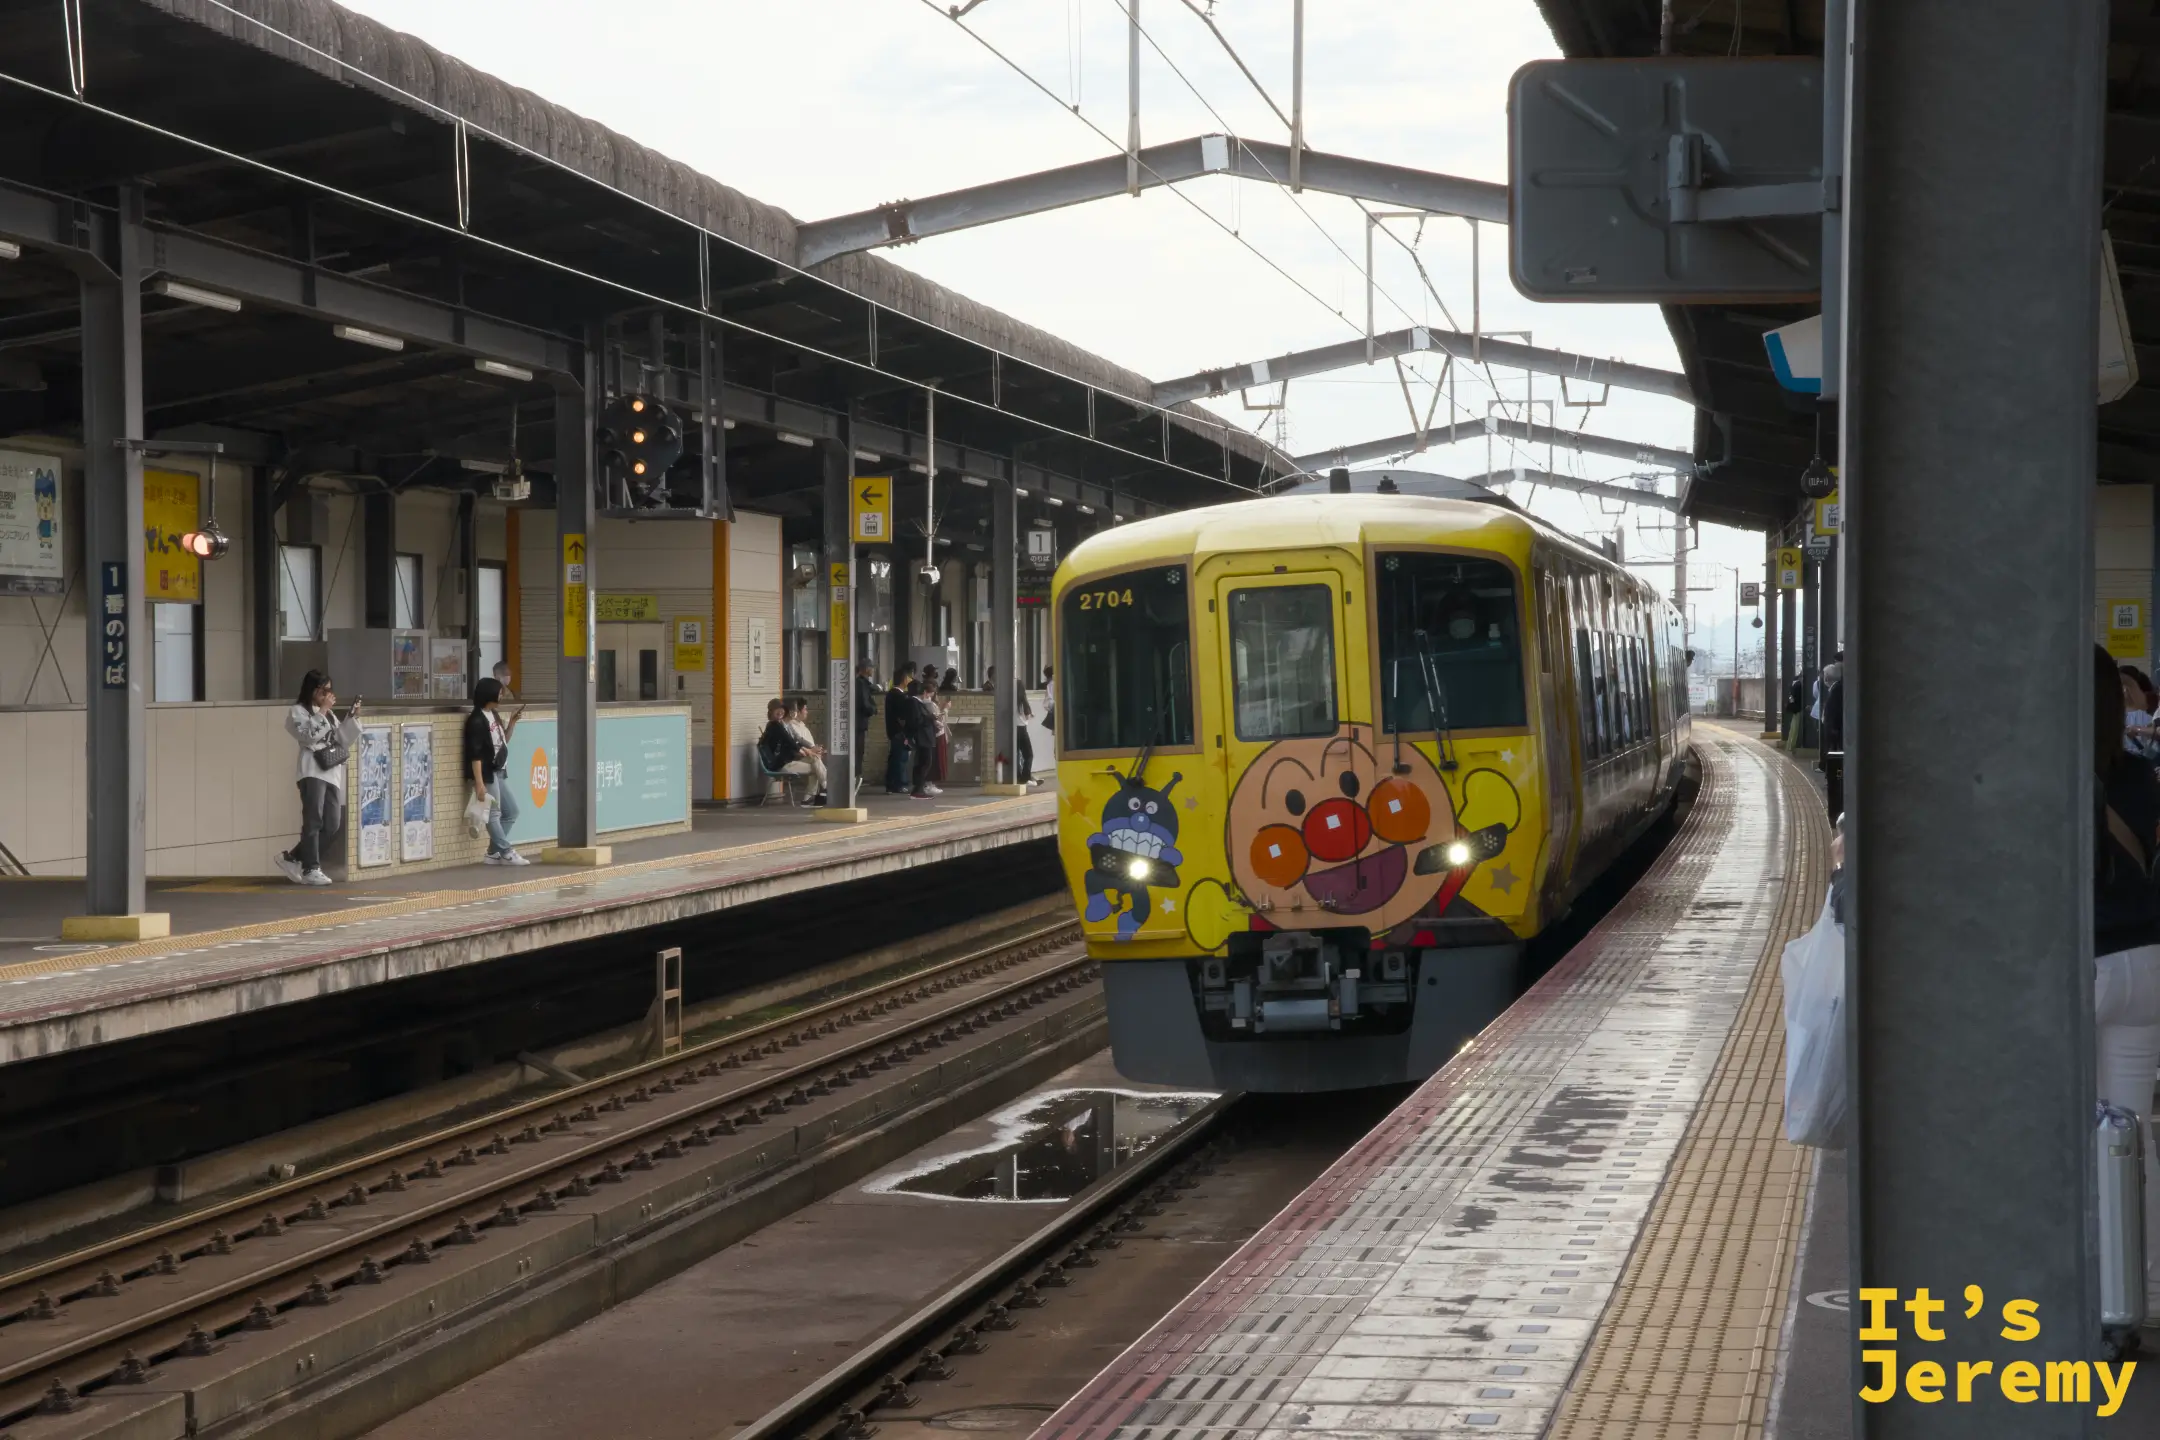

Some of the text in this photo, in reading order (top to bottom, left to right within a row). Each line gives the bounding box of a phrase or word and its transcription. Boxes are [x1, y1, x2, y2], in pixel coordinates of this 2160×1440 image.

[1036, 534, 1042, 553] 1
[1080, 588, 1133, 610] 2704
[1744, 585, 1755, 597] 2
[105, 566, 126, 685] 1番のりば
[532, 765, 548, 790] 459
